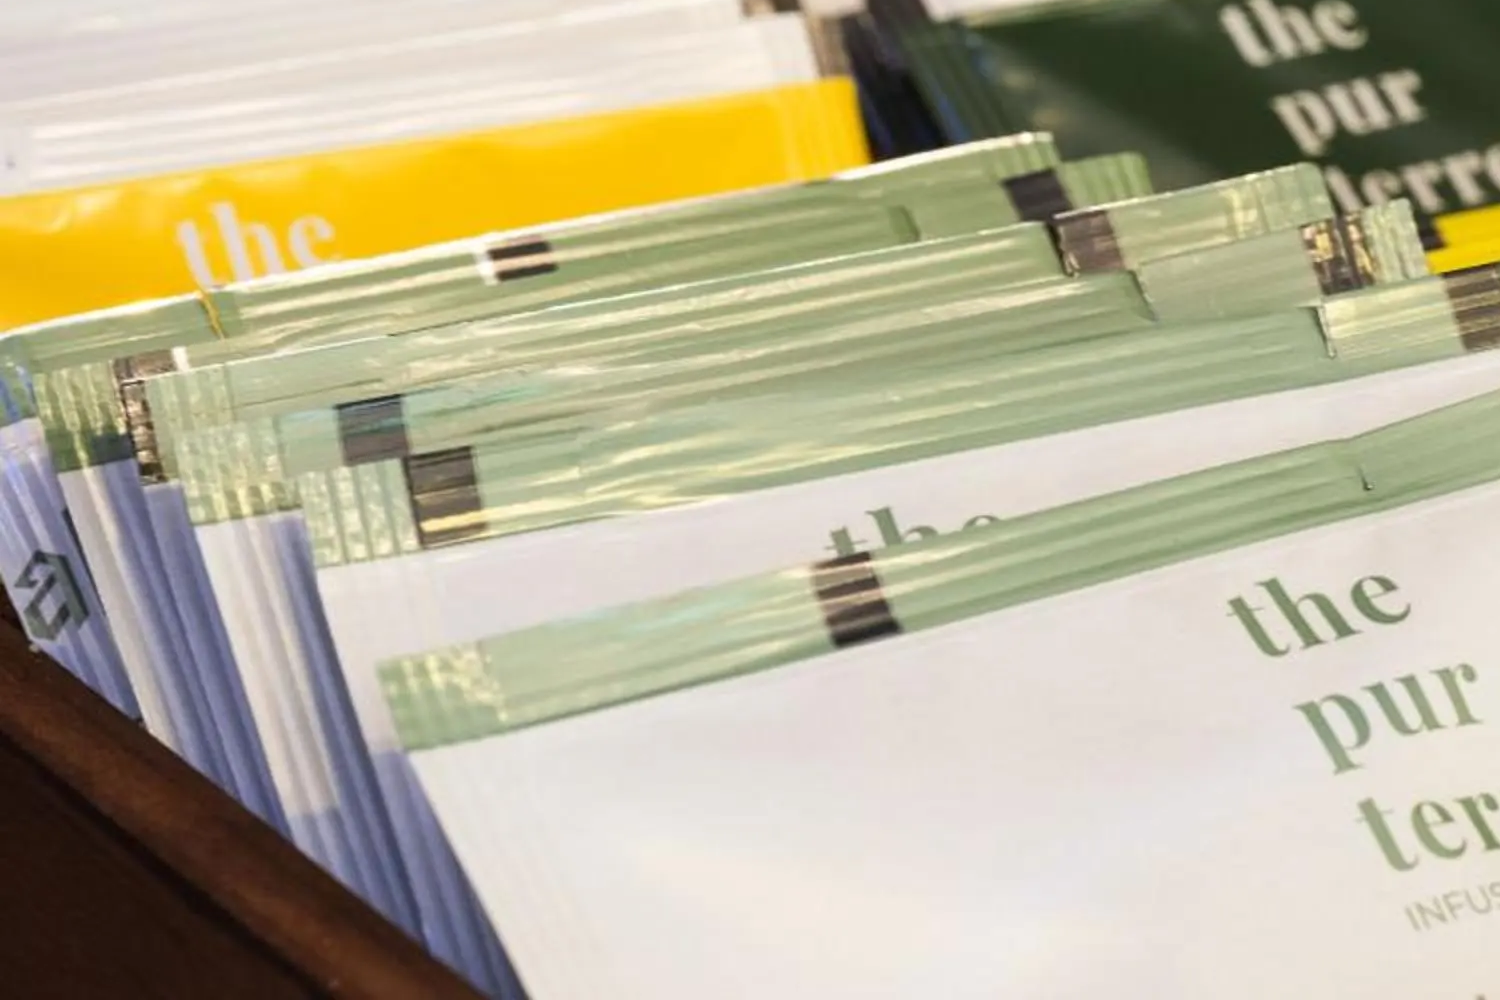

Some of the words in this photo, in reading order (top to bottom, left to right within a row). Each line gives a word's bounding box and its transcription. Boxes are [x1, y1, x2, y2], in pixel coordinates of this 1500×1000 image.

[1270, 66, 1427, 156] pur
[175, 199, 338, 290] the
[1226, 573, 1411, 659] the
[1292, 660, 1484, 774] pur
